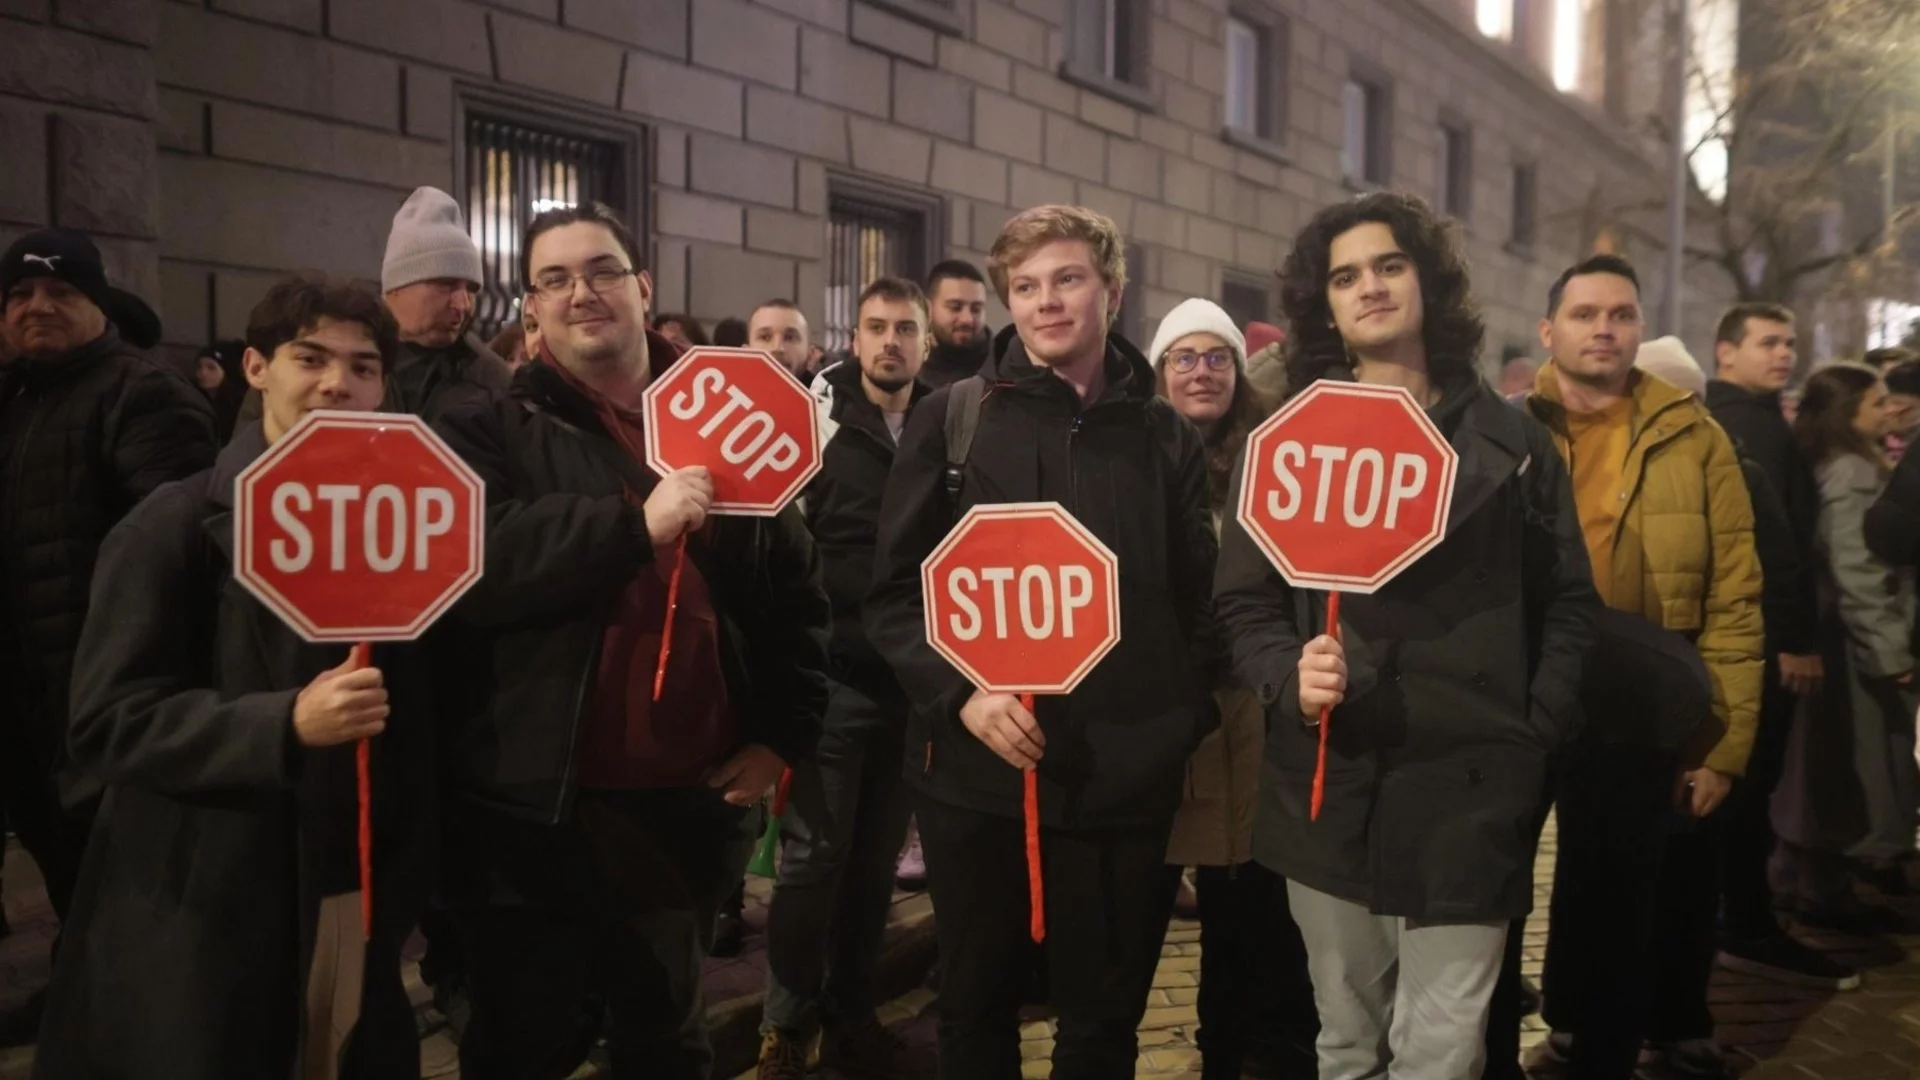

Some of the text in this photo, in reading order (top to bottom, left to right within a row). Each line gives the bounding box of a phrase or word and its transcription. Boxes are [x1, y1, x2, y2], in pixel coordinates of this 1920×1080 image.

[669, 367, 801, 482] STOP
[270, 482, 455, 573] STOP
[1267, 439, 1428, 530] STOP
[948, 564, 1094, 641] STOP
